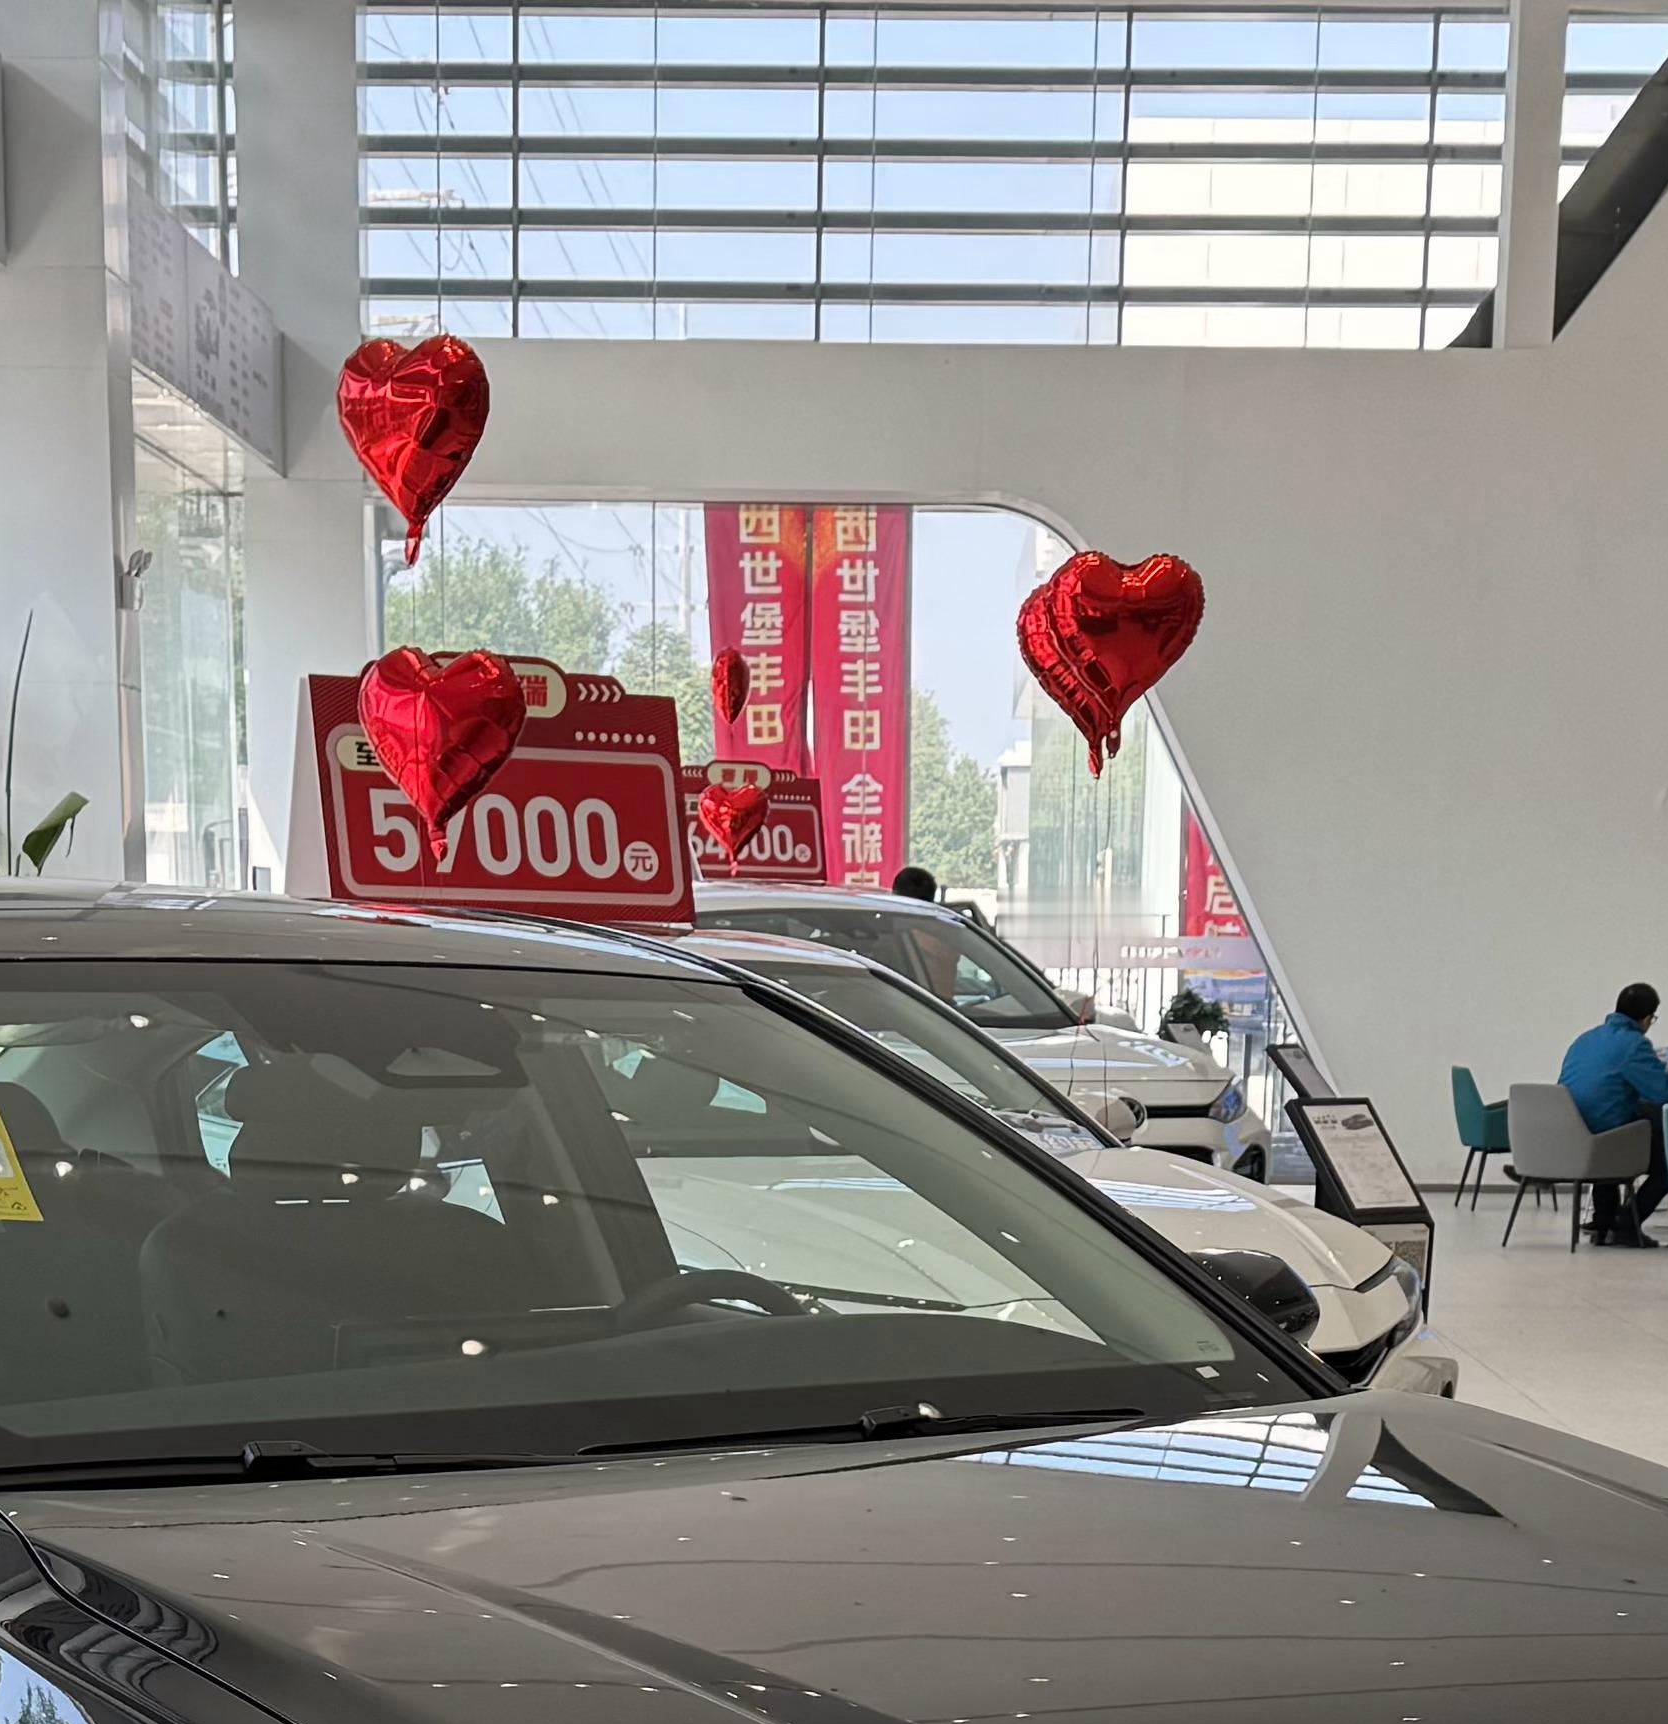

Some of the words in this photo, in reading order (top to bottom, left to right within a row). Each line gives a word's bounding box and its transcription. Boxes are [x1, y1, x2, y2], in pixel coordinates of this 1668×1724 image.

[738, 504, 785, 745] 西世堡丰田
